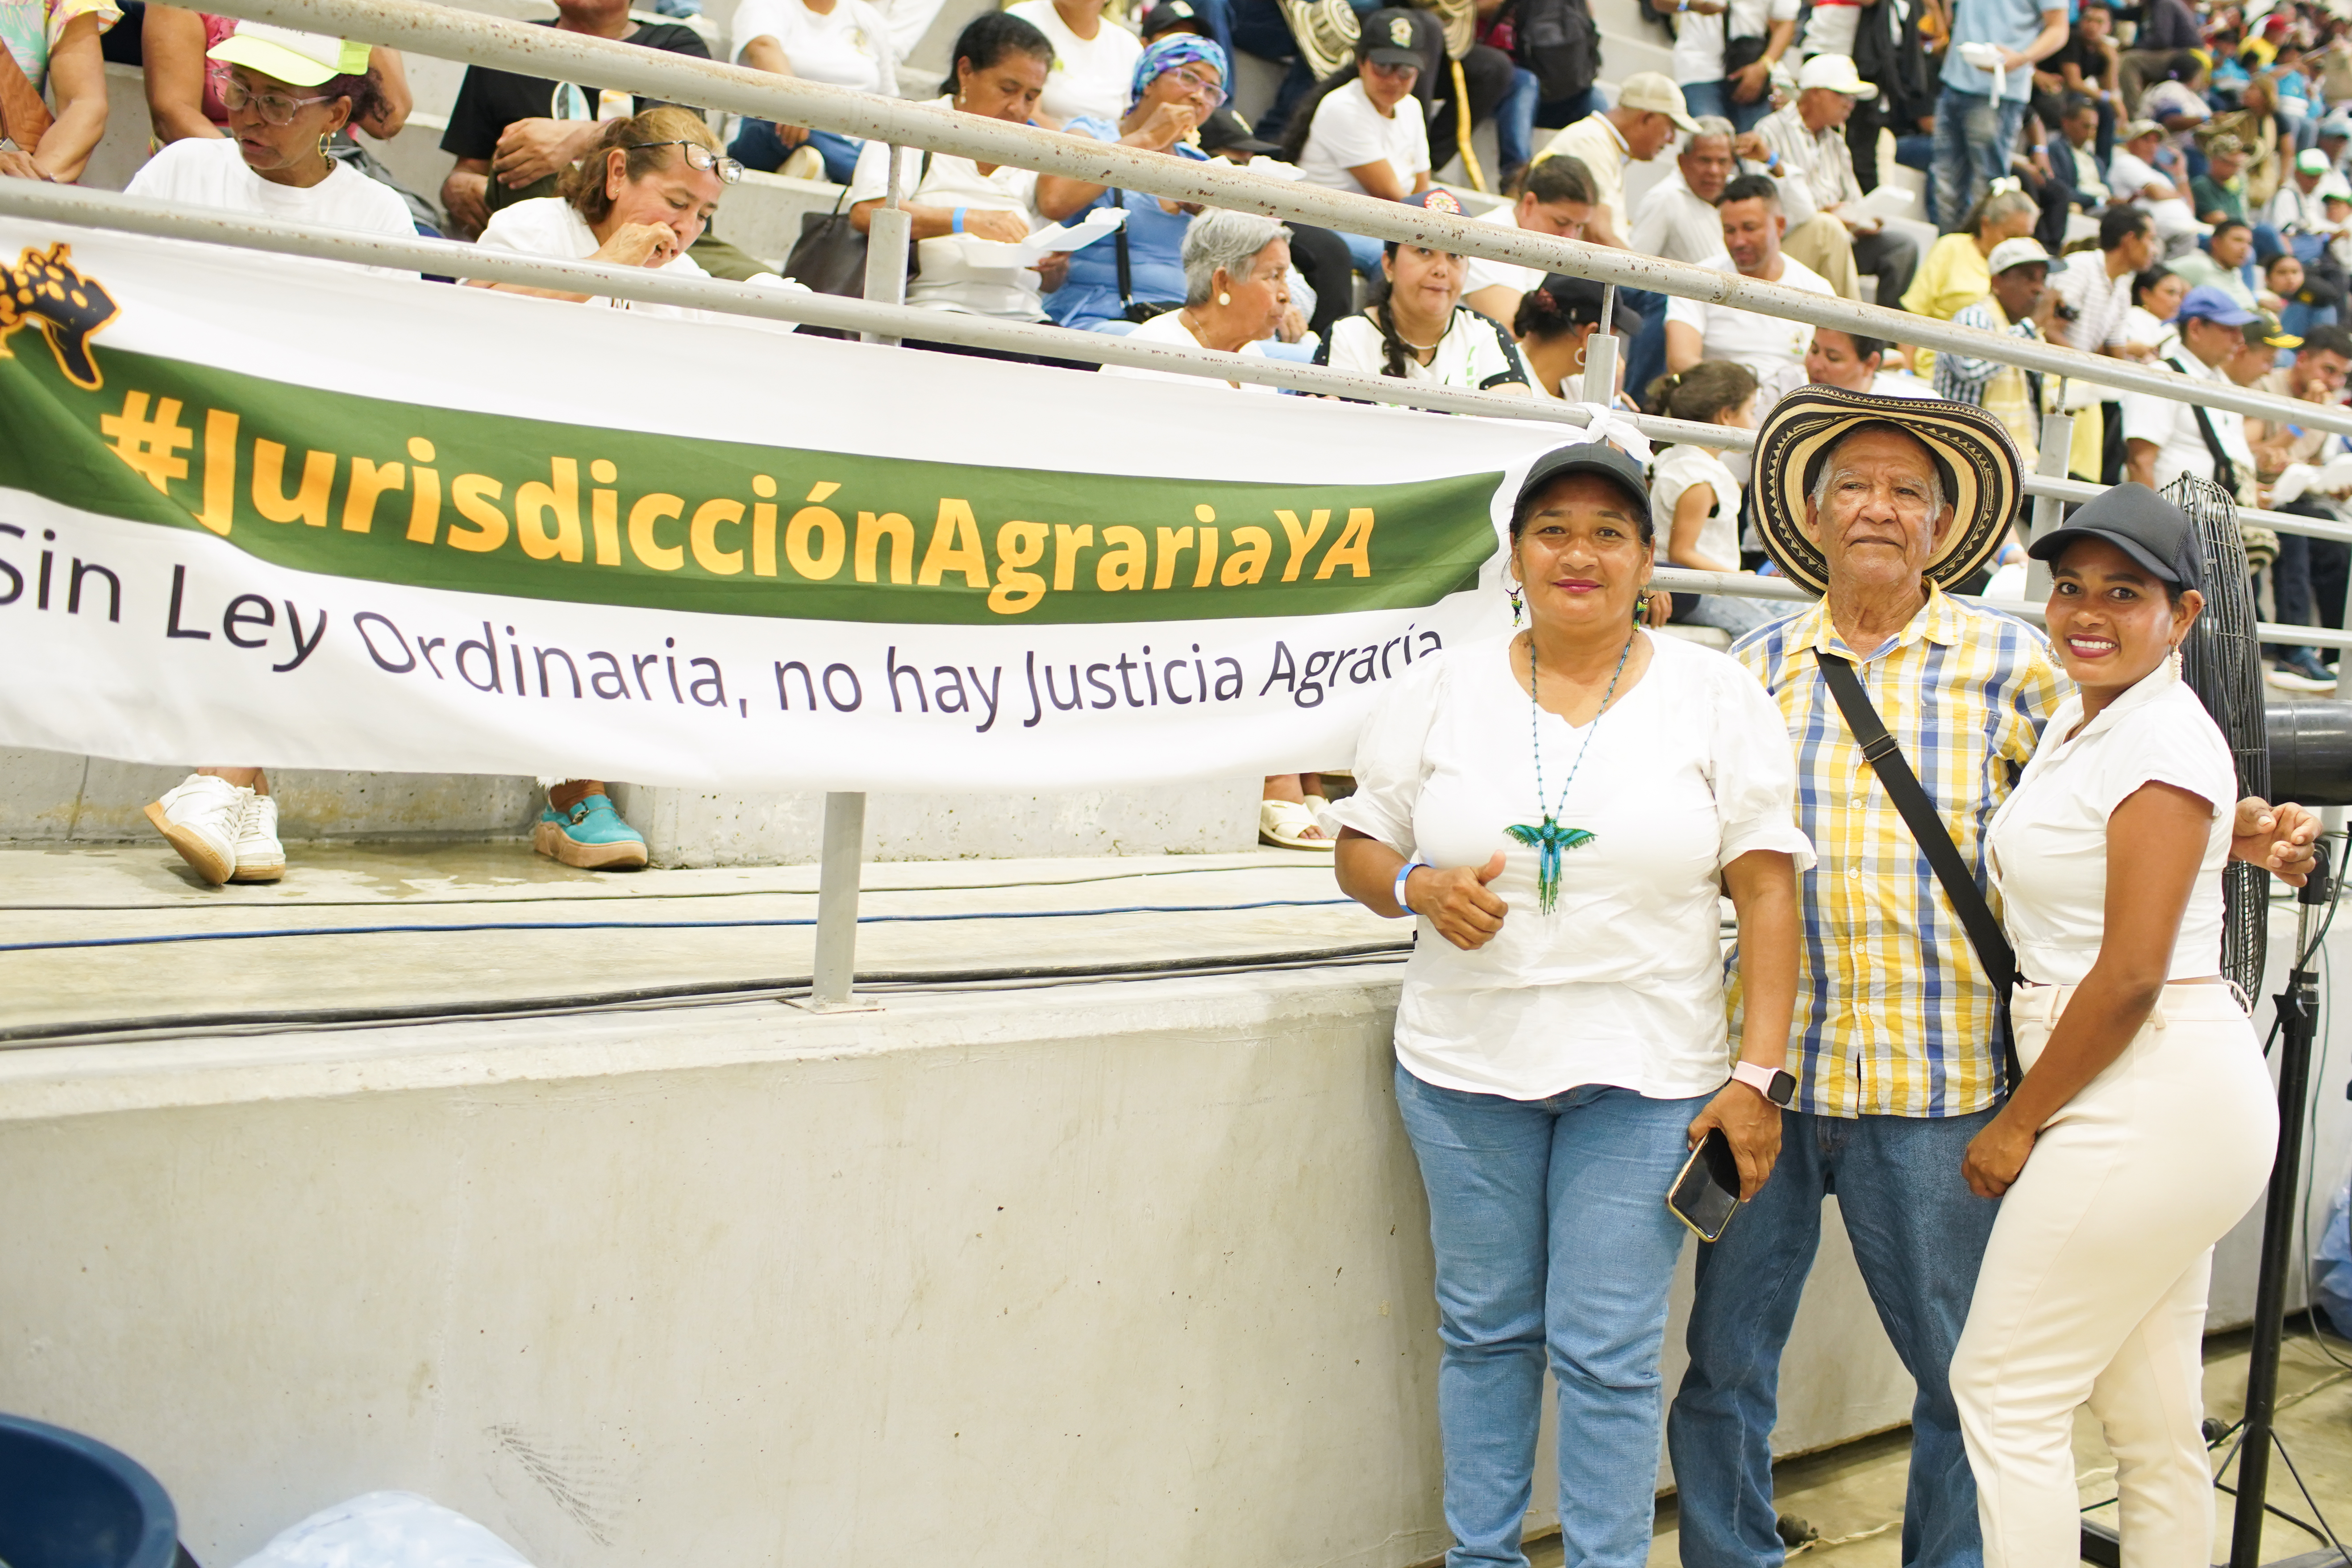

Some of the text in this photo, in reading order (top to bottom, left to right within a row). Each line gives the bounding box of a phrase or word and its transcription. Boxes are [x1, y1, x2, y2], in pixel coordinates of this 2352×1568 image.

[101, 391, 1374, 614] #JurisdicciónAgrariaYA
[167, 564, 327, 673] Ley
[354, 611, 747, 718] Ordinaria,
[775, 661, 862, 712] no
[887, 646, 1002, 733] hay
[1023, 643, 1243, 727] Justicia
